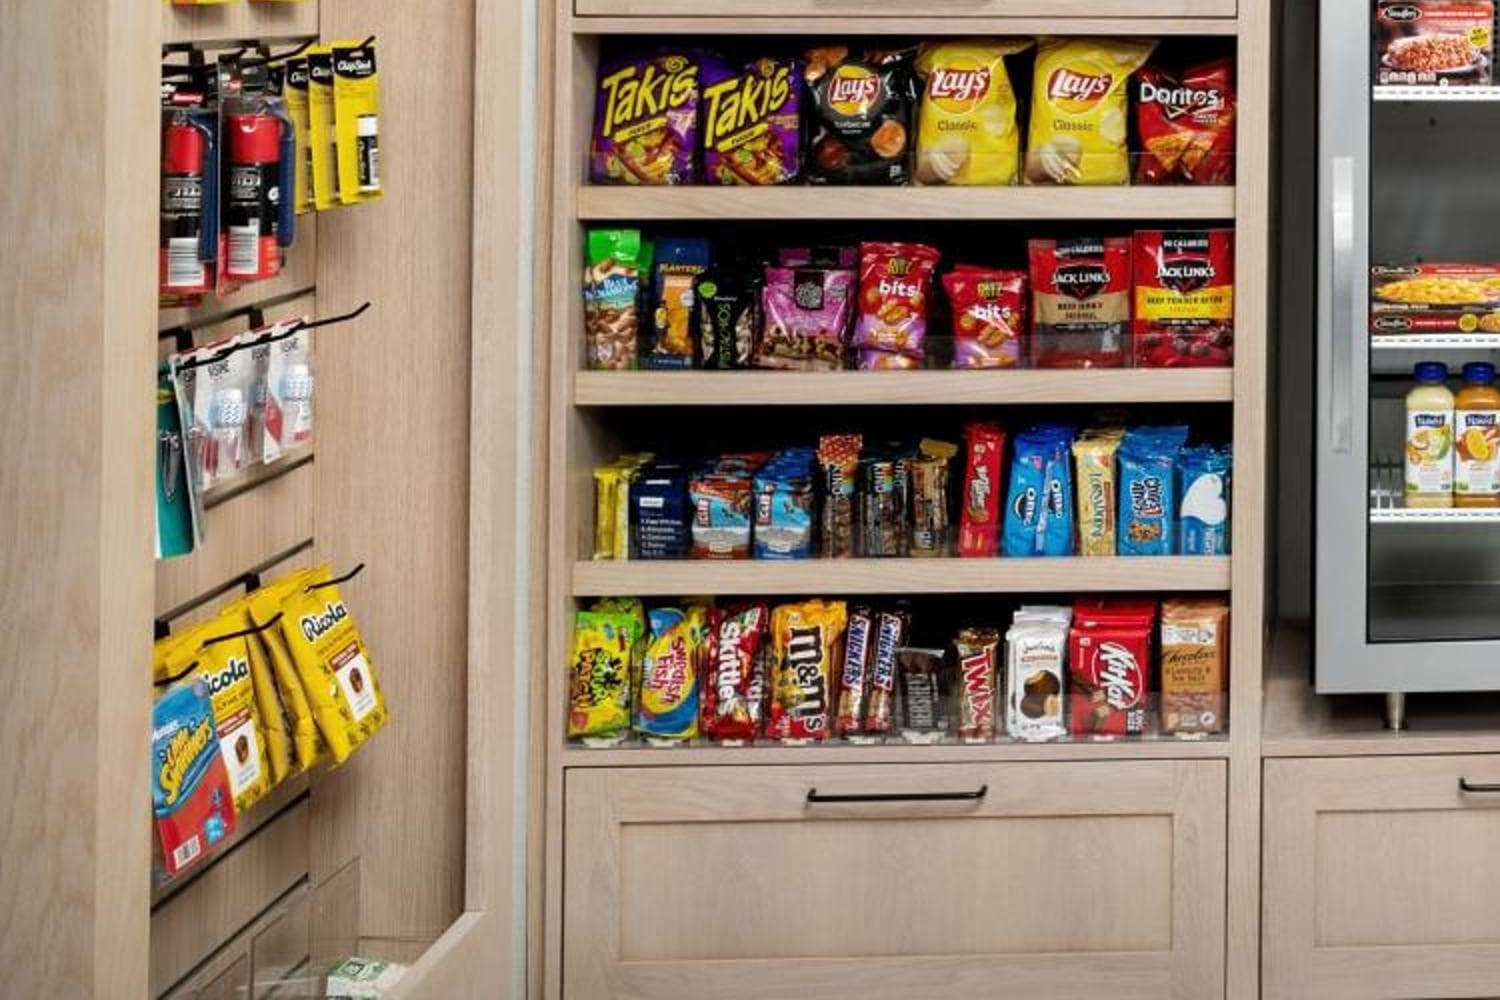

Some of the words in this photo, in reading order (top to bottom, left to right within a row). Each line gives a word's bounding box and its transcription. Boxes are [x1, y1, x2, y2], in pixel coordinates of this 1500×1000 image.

[602, 64, 698, 138] Takis
[703, 67, 791, 148] Takis
[1140, 81, 1223, 106] Doritos
[302, 601, 348, 643] Ricola
[206, 659, 249, 697] icola
[962, 645, 993, 723] TWIX
